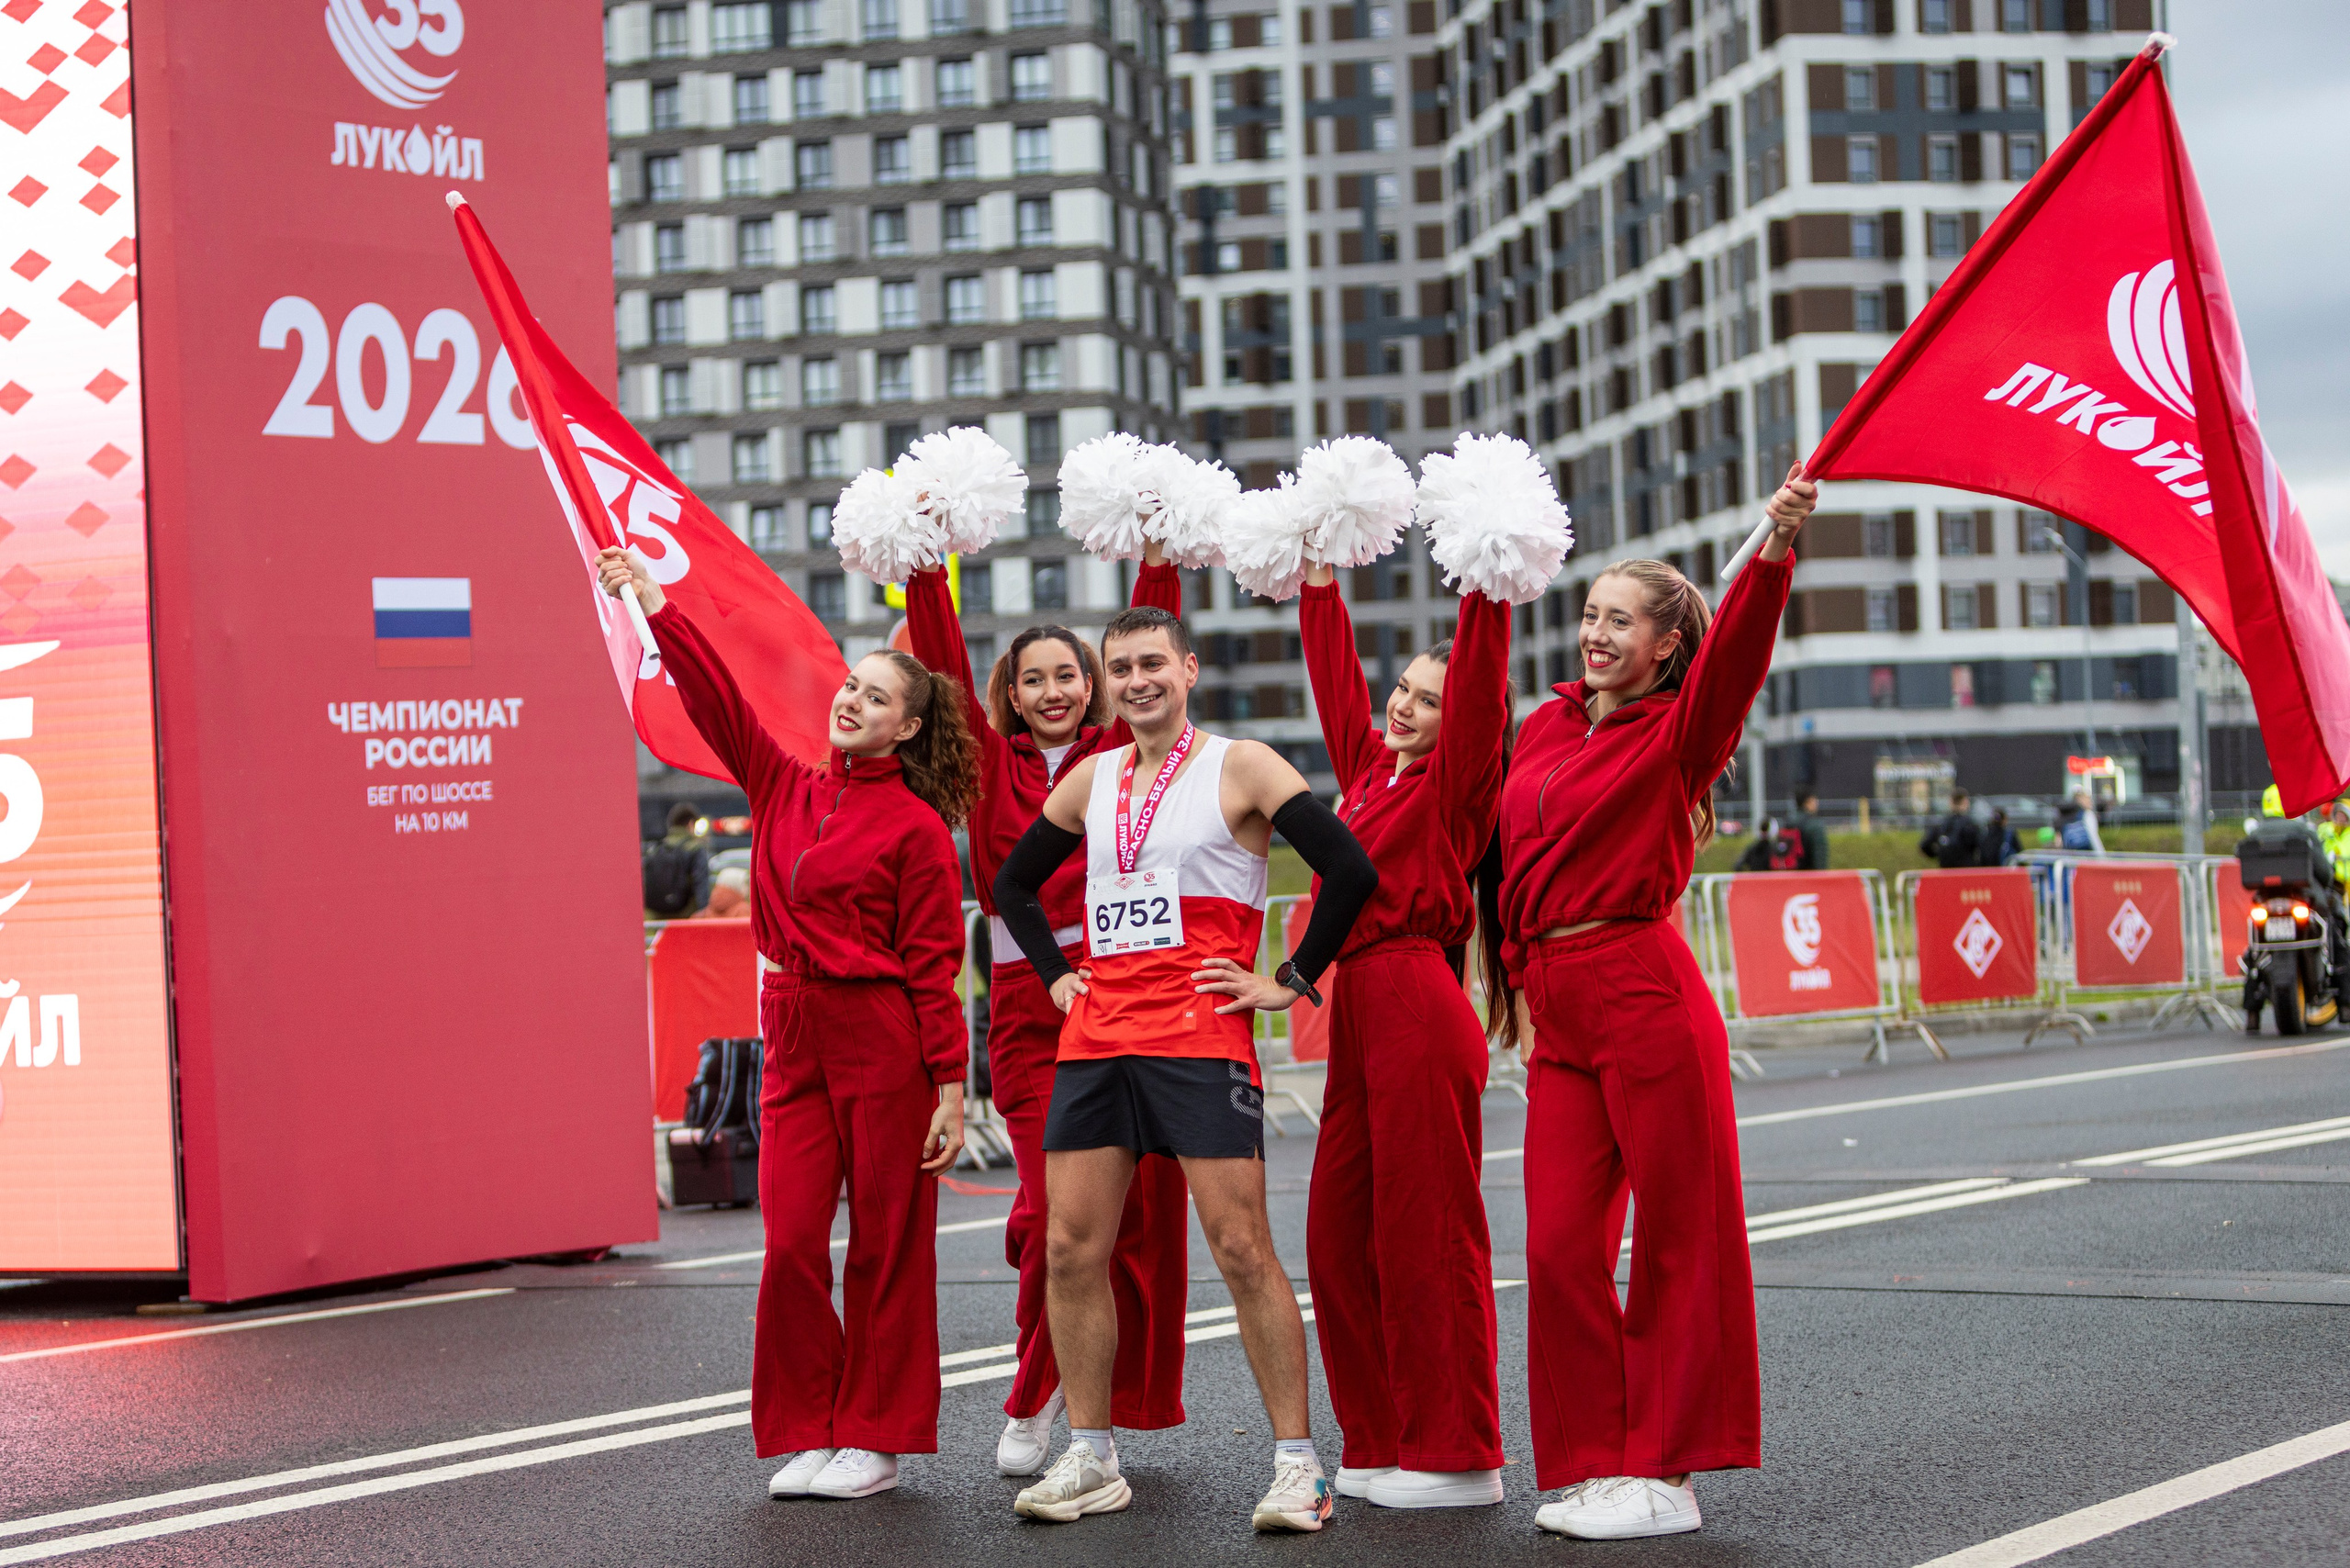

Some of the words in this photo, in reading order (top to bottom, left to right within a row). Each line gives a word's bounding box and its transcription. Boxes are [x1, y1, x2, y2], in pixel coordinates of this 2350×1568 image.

[330, 121, 485, 182] ЛУКОЙЛ
[328, 698, 523, 734] ЧЕМПИОНАТ
[364, 734, 492, 769] РОССИИ
[367, 785, 399, 807] БЕГ
[401, 783, 429, 804] ПО
[431, 780, 494, 803] ШОССЕ
[1125, 750, 1183, 870] КРАСНО-БЕЛЫЙ
[395, 813, 420, 834] НА
[421, 812, 441, 832] 10
[442, 810, 469, 831] КМ
[1096, 897, 1171, 933] 6752
